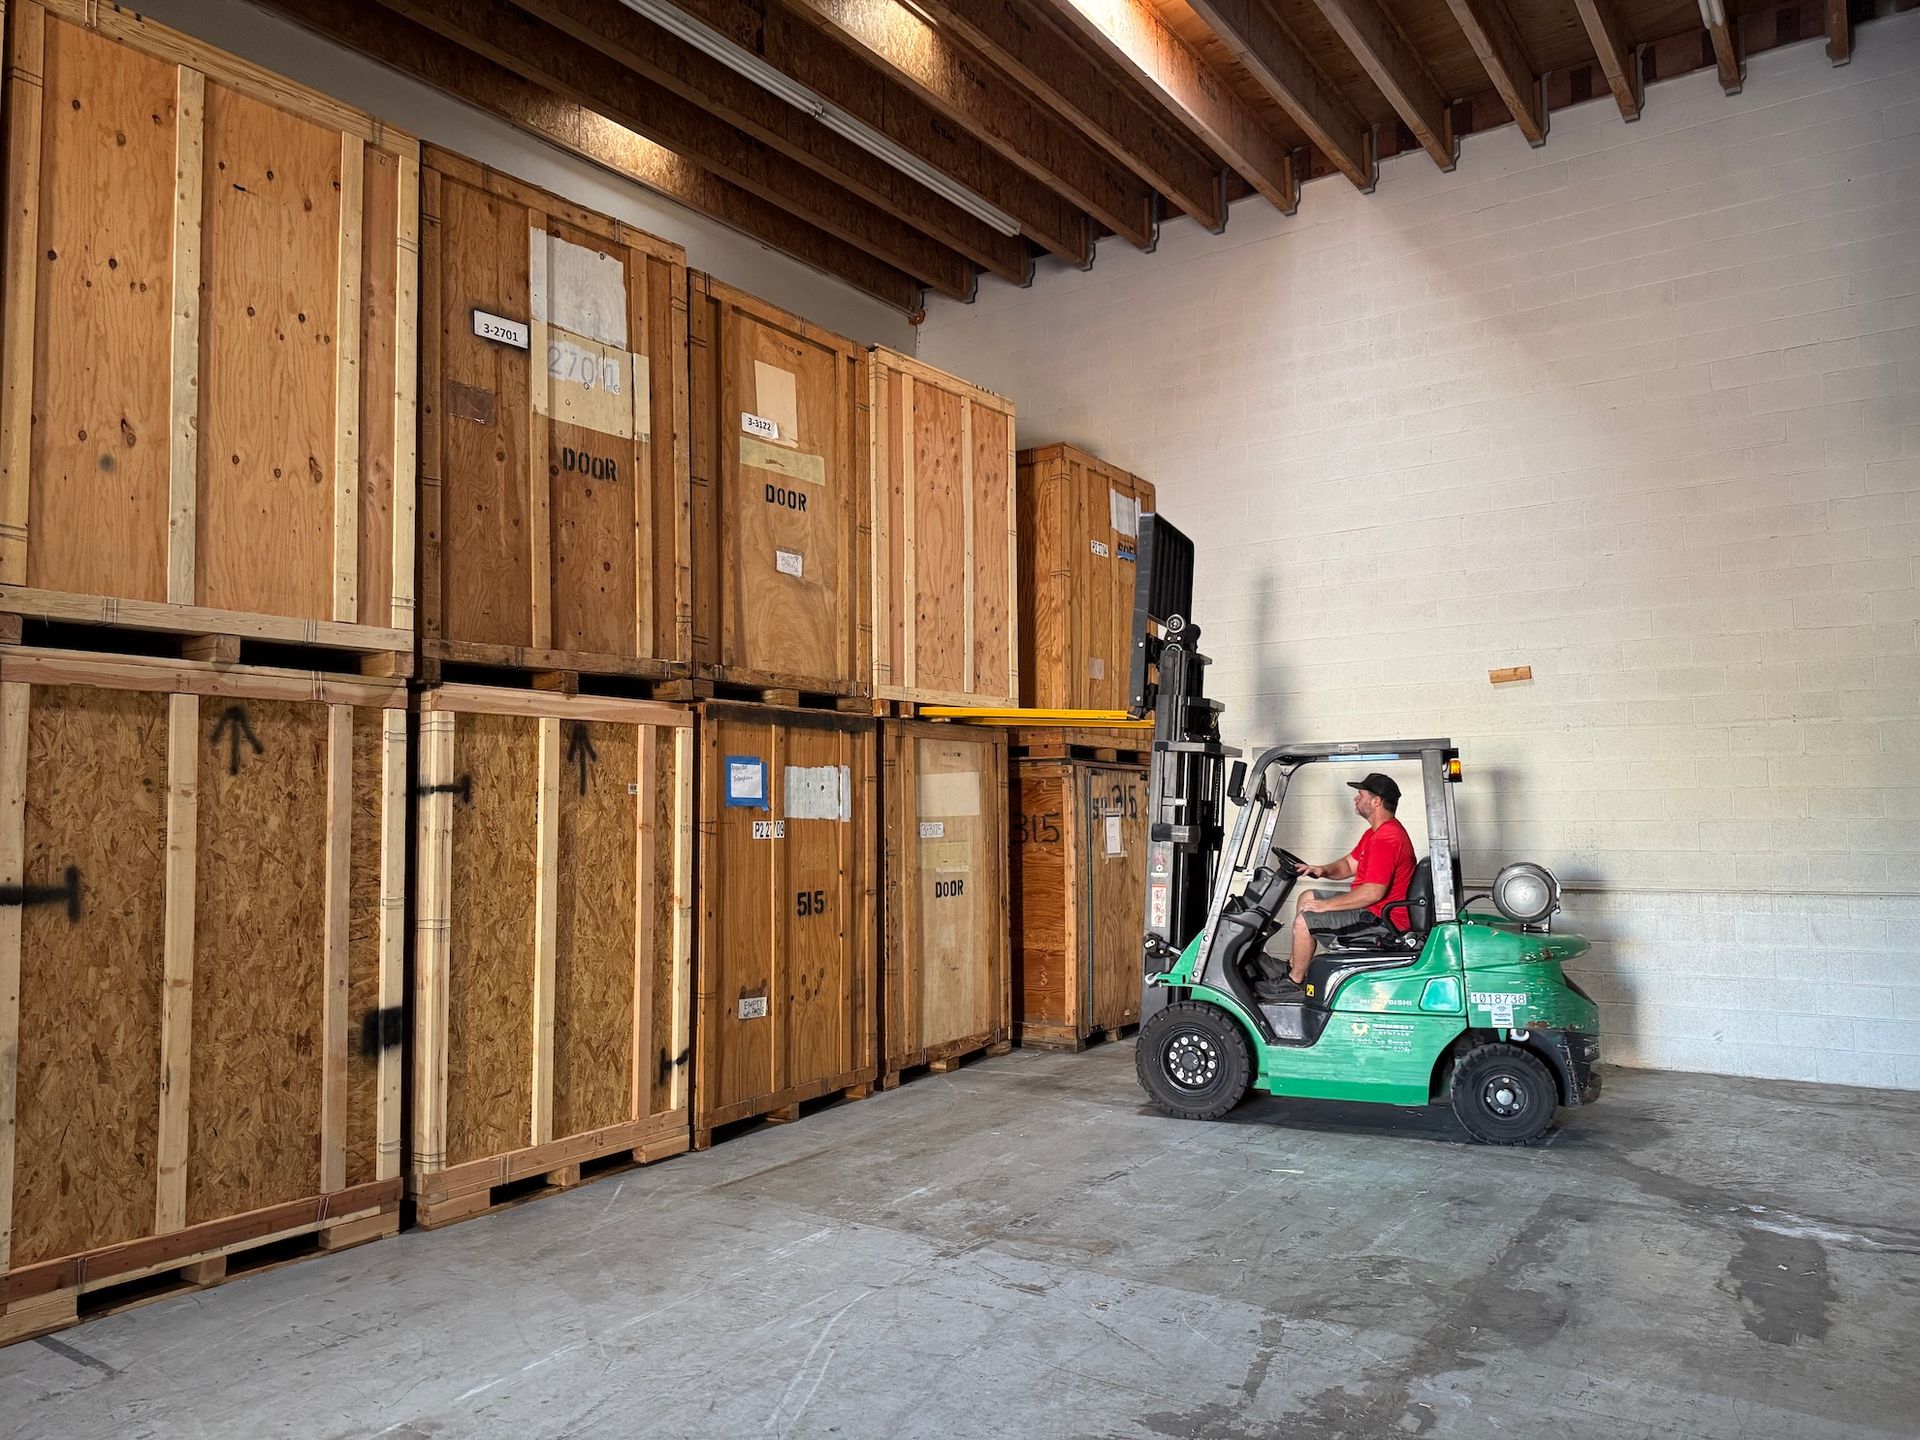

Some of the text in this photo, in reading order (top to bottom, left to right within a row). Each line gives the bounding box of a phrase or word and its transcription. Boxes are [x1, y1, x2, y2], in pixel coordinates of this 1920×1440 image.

[483, 323, 519, 342] 3-2701
[747, 417, 771, 432] 3-3122
[562, 447, 617, 482] DOOR
[765, 483, 807, 512] DOOR
[1012, 811, 1060, 843] 315
[935, 879, 964, 899] DOOR
[797, 890, 825, 917] 515
[1472, 993, 1526, 1005] 1018738
